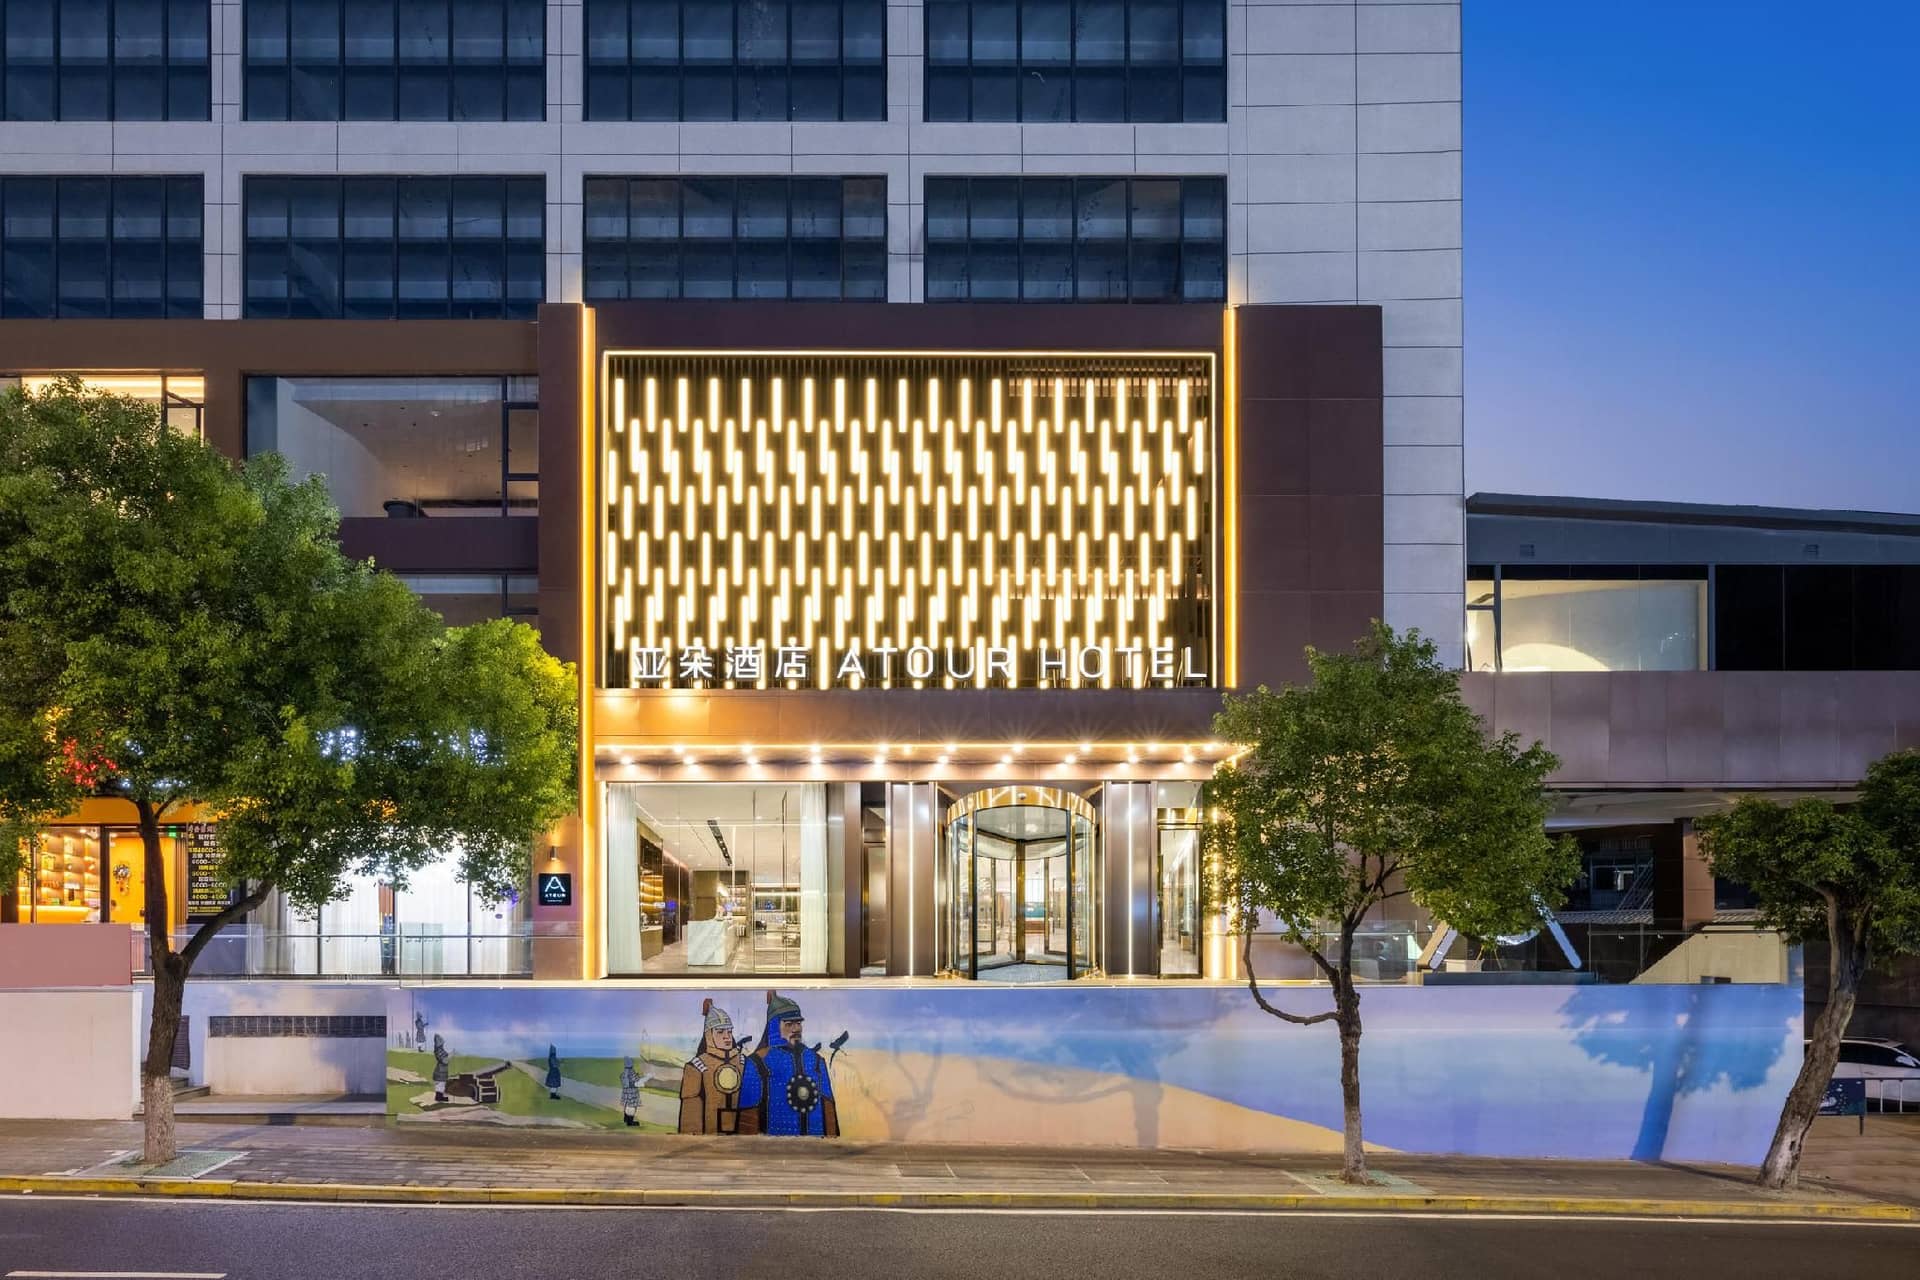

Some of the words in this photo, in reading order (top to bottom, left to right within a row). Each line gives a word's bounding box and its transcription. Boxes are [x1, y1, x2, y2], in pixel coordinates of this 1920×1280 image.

[633, 646, 809, 679] 亚朵酒店
[836, 645, 1014, 679] ATOUR
[1040, 646, 1208, 679] HOTEL
